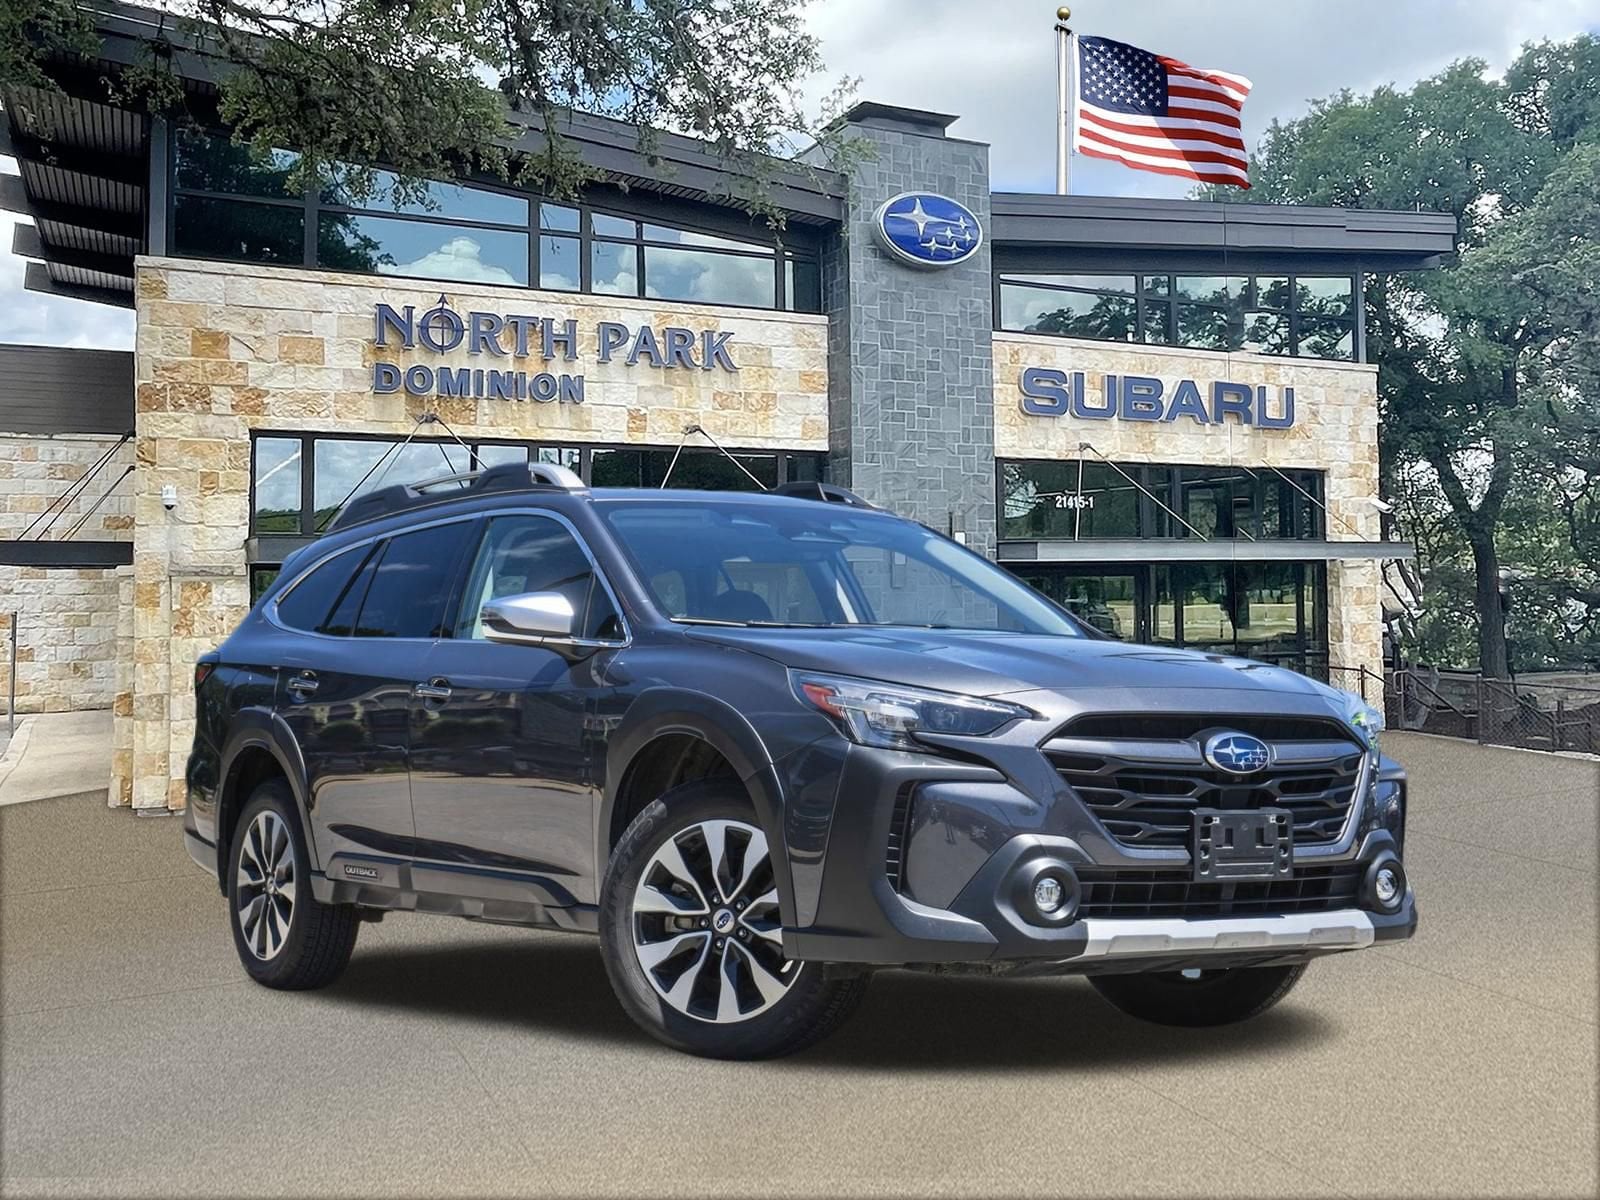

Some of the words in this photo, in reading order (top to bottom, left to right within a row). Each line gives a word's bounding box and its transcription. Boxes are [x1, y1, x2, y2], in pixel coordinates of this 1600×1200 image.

[374, 297, 579, 362] NORTH
[597, 320, 741, 373] PARK
[373, 362, 585, 404] DOMINION
[1019, 366, 1295, 429] SUBARU
[345, 865, 377, 877] OUTBACK
